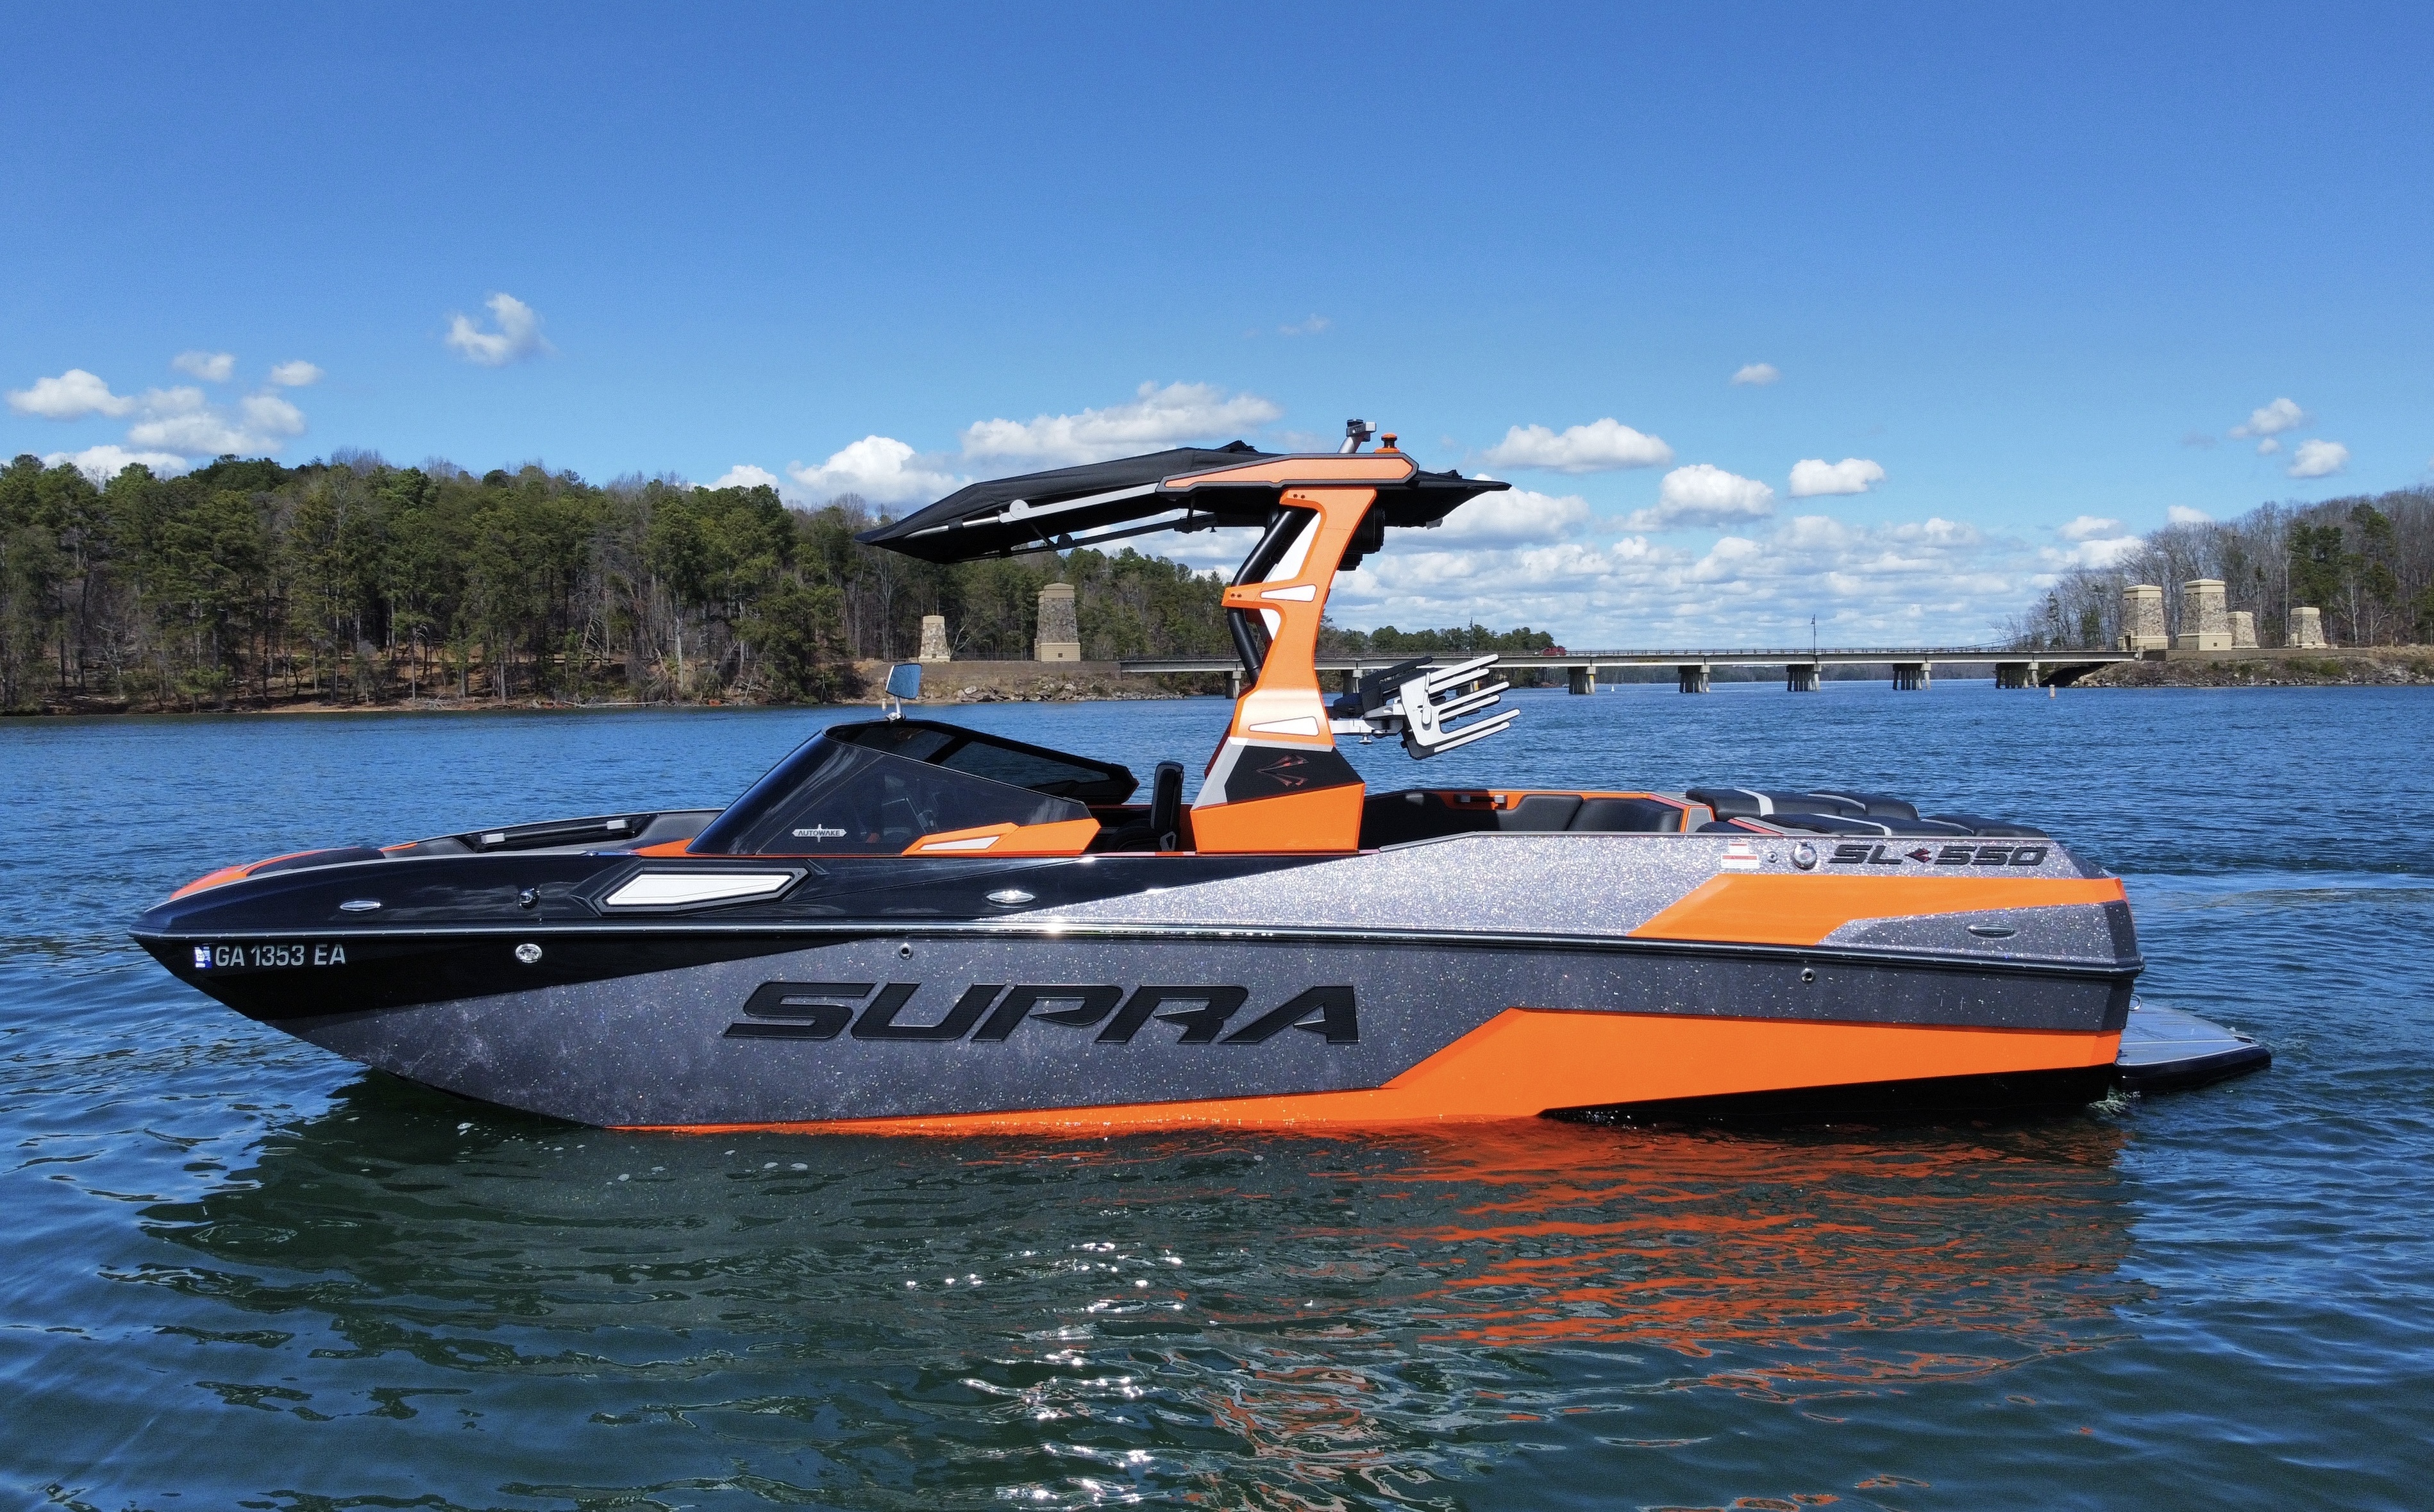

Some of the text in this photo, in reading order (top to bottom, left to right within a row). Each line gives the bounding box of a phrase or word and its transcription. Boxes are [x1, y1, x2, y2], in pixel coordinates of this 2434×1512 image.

[1827, 844, 2049, 866] SL 550
[215, 944, 346, 966] GA 1353 EA
[723, 982, 1359, 1044] SUPRA
